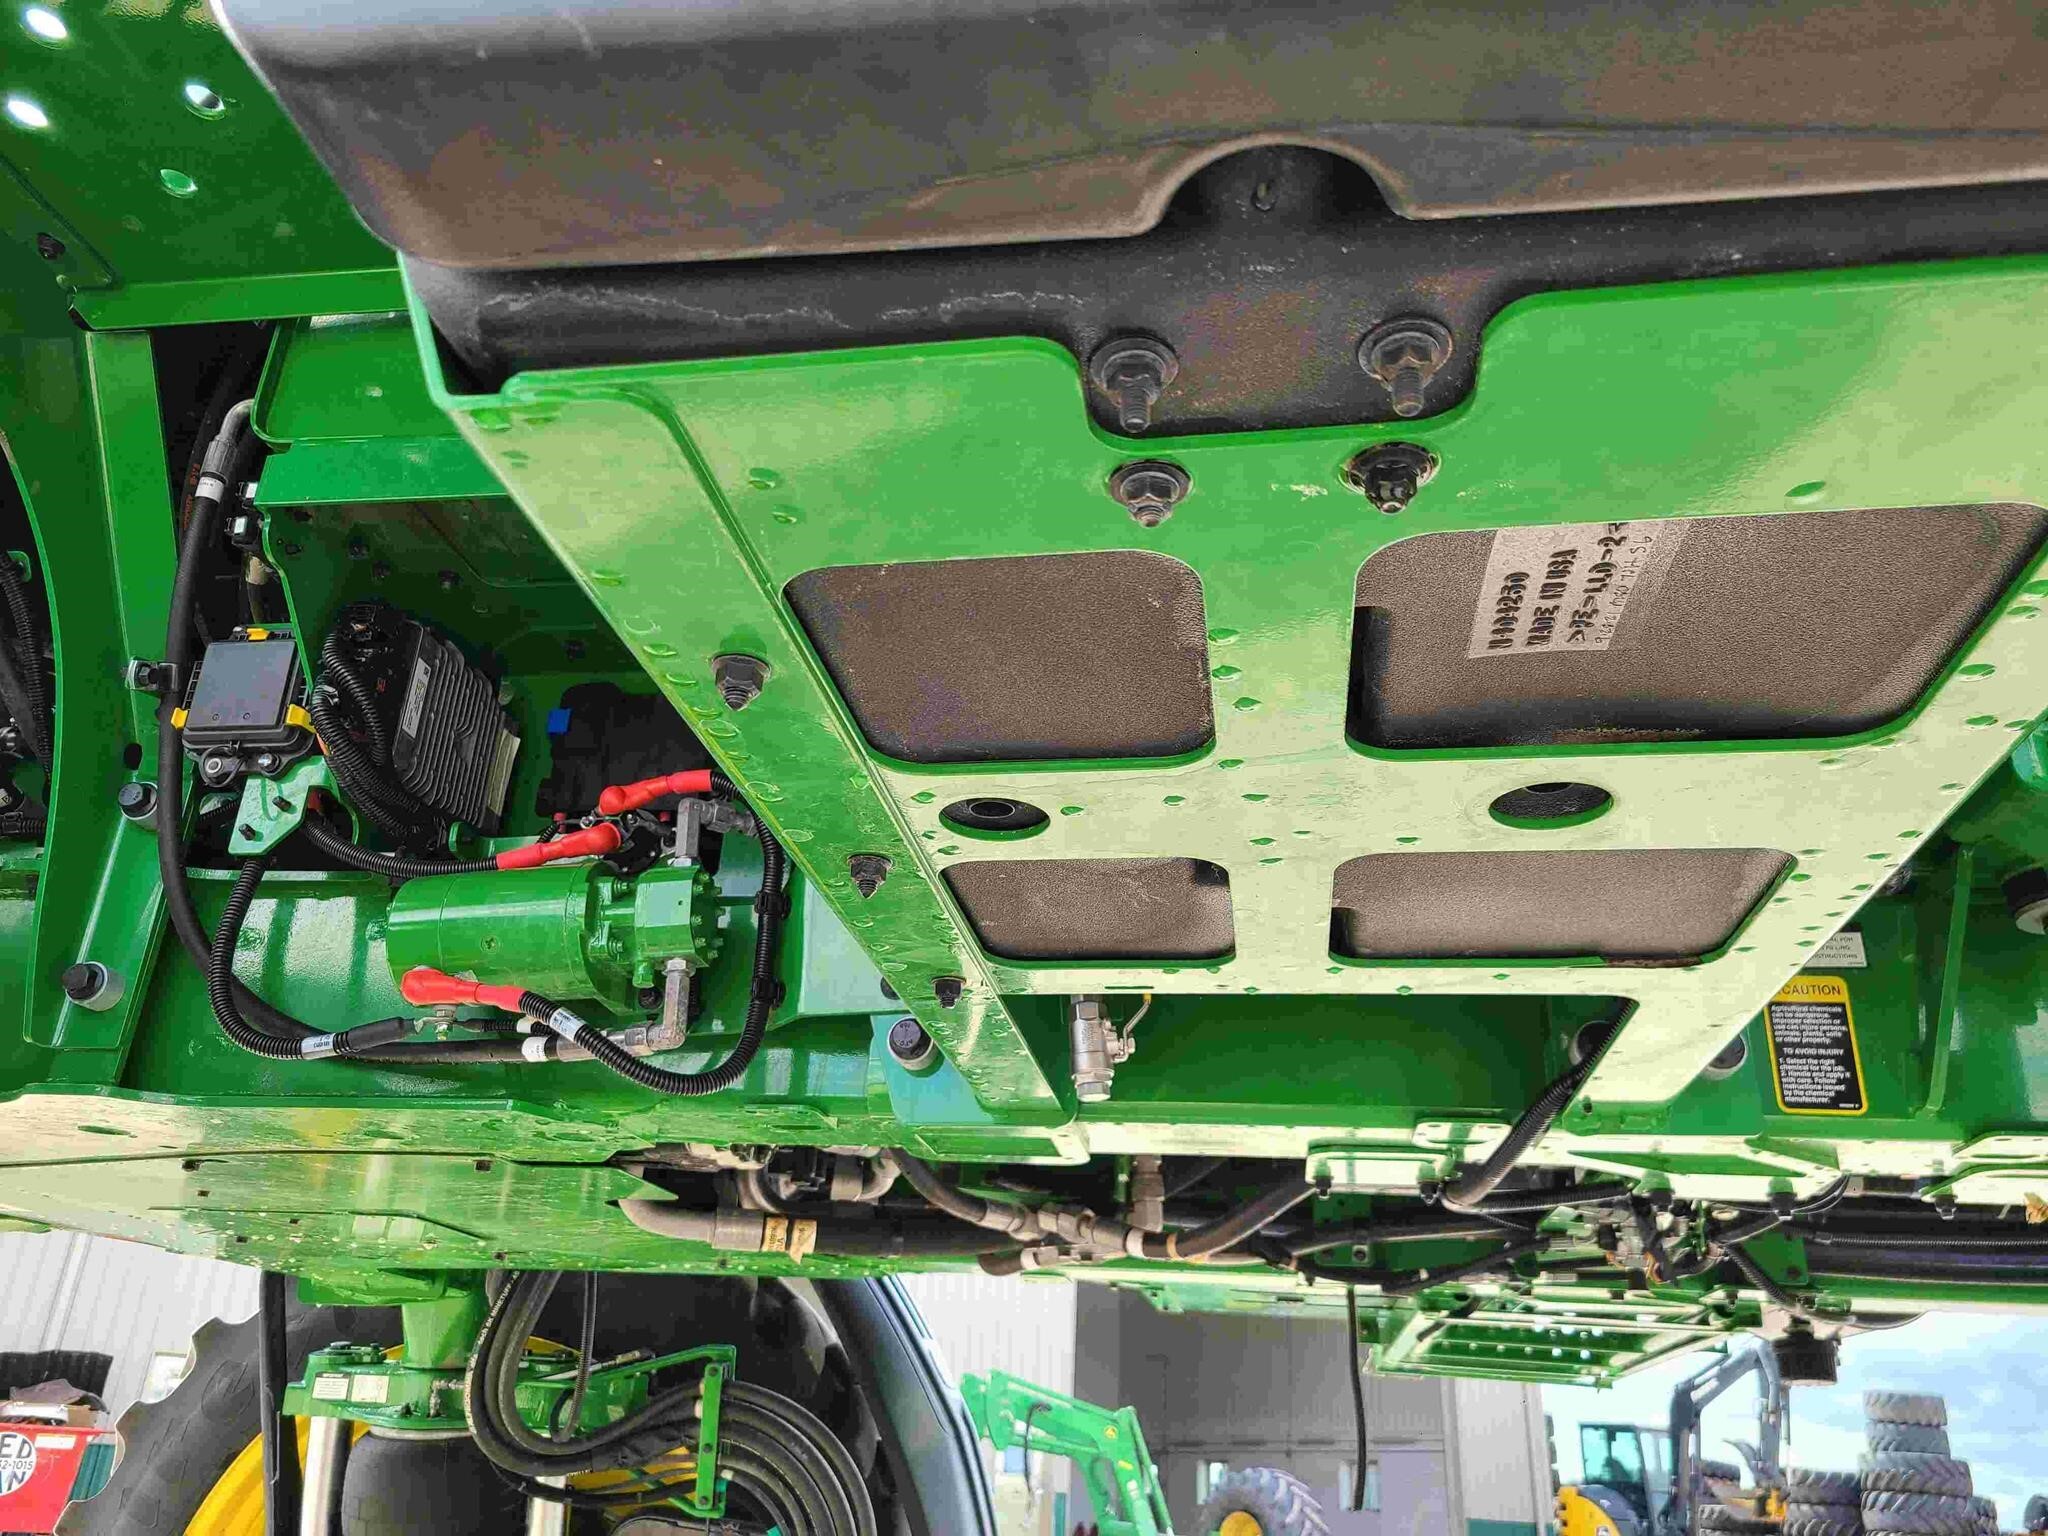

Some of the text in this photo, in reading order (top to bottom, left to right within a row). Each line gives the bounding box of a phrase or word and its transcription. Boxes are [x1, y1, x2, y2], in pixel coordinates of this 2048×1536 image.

[1526, 549, 1578, 646] MADE IN USA
[1782, 985, 1841, 995] CAUTION
[1795, 1048, 1817, 1056] AVOID
[1818, 1048, 1844, 1056] INJURY
[1819, 1058, 1835, 1066] right
[1823, 1083, 1846, 1091] issued
